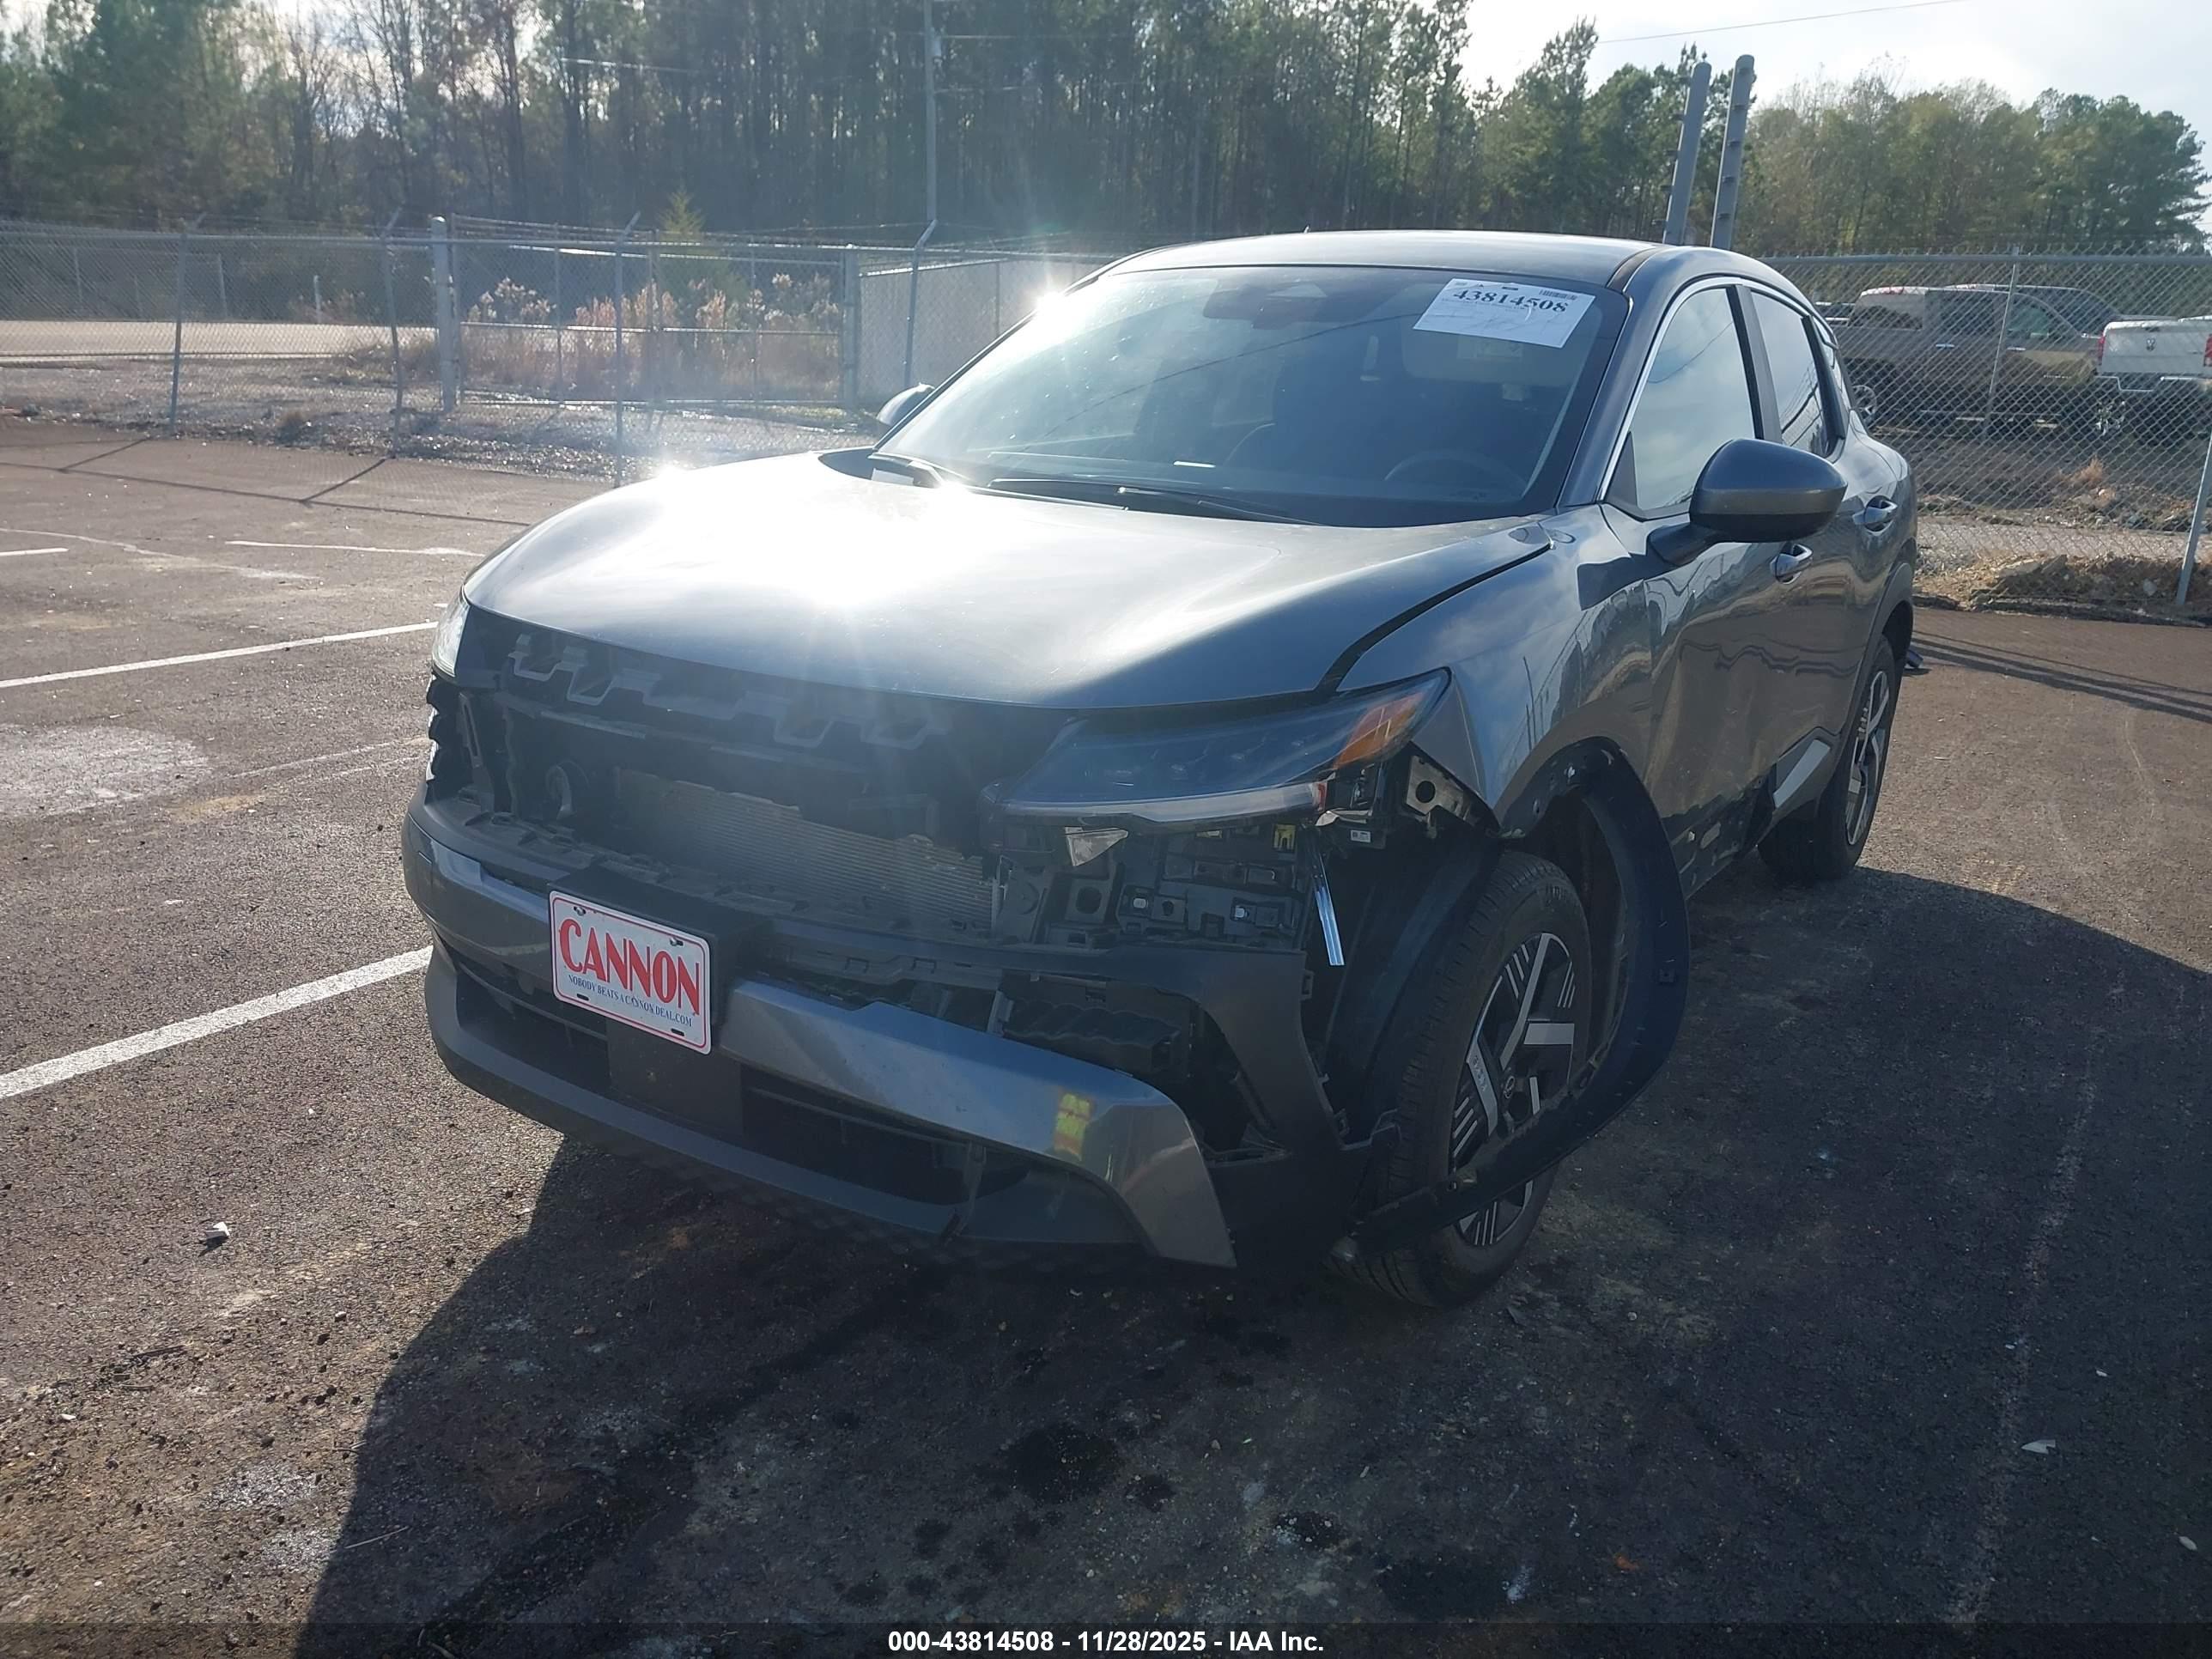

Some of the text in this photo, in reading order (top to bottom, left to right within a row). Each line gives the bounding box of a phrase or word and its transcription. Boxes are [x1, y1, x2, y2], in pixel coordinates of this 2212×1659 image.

[1453, 289, 1569, 313] 43814508
[559, 918, 700, 1016] CANNON
[568, 974, 595, 992] NOBODY
[597, 984, 619, 1000] BEATS
